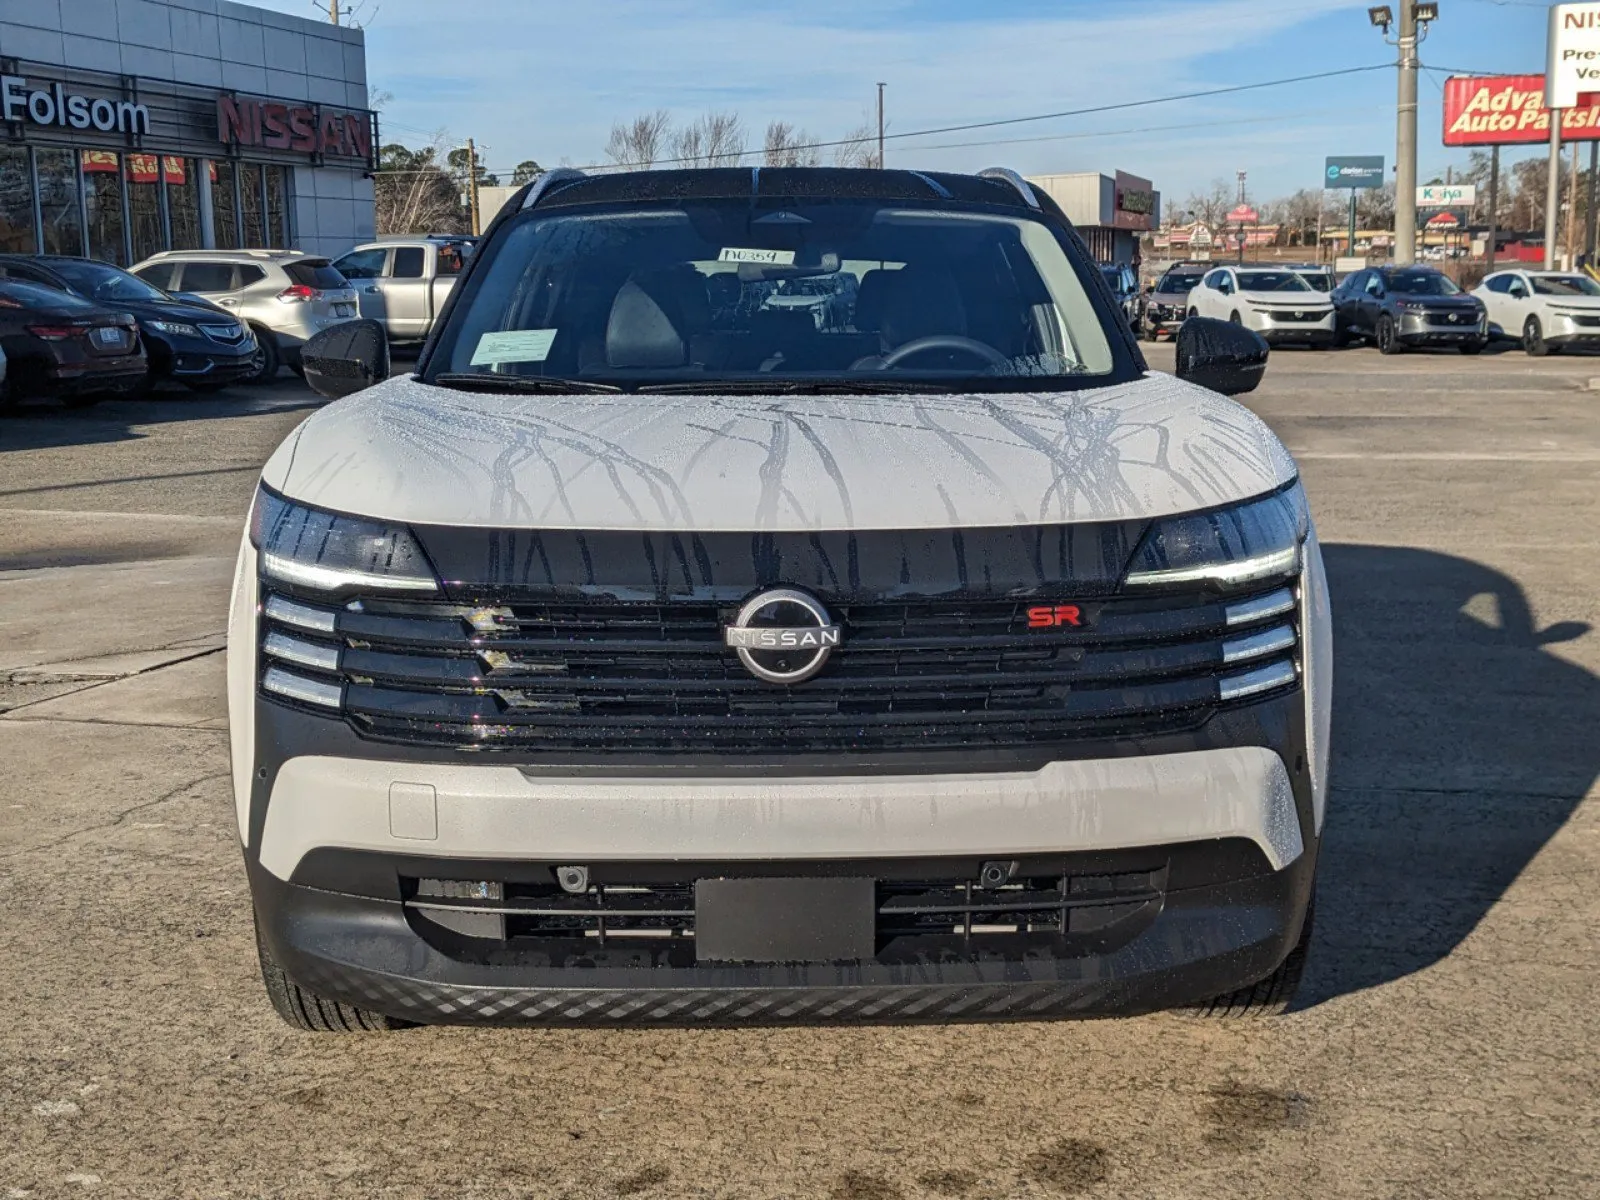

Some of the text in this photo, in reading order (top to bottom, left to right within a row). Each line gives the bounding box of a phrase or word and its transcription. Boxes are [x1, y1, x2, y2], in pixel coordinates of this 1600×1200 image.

[1565, 12, 1600, 29] NI
[1464, 86, 1545, 112] Adva
[1, 75, 368, 158] Folsom NISSAN
[1449, 108, 1589, 133] Auto Pats
[1028, 604, 1081, 627] SR
[729, 628, 838, 647] NISSAN
